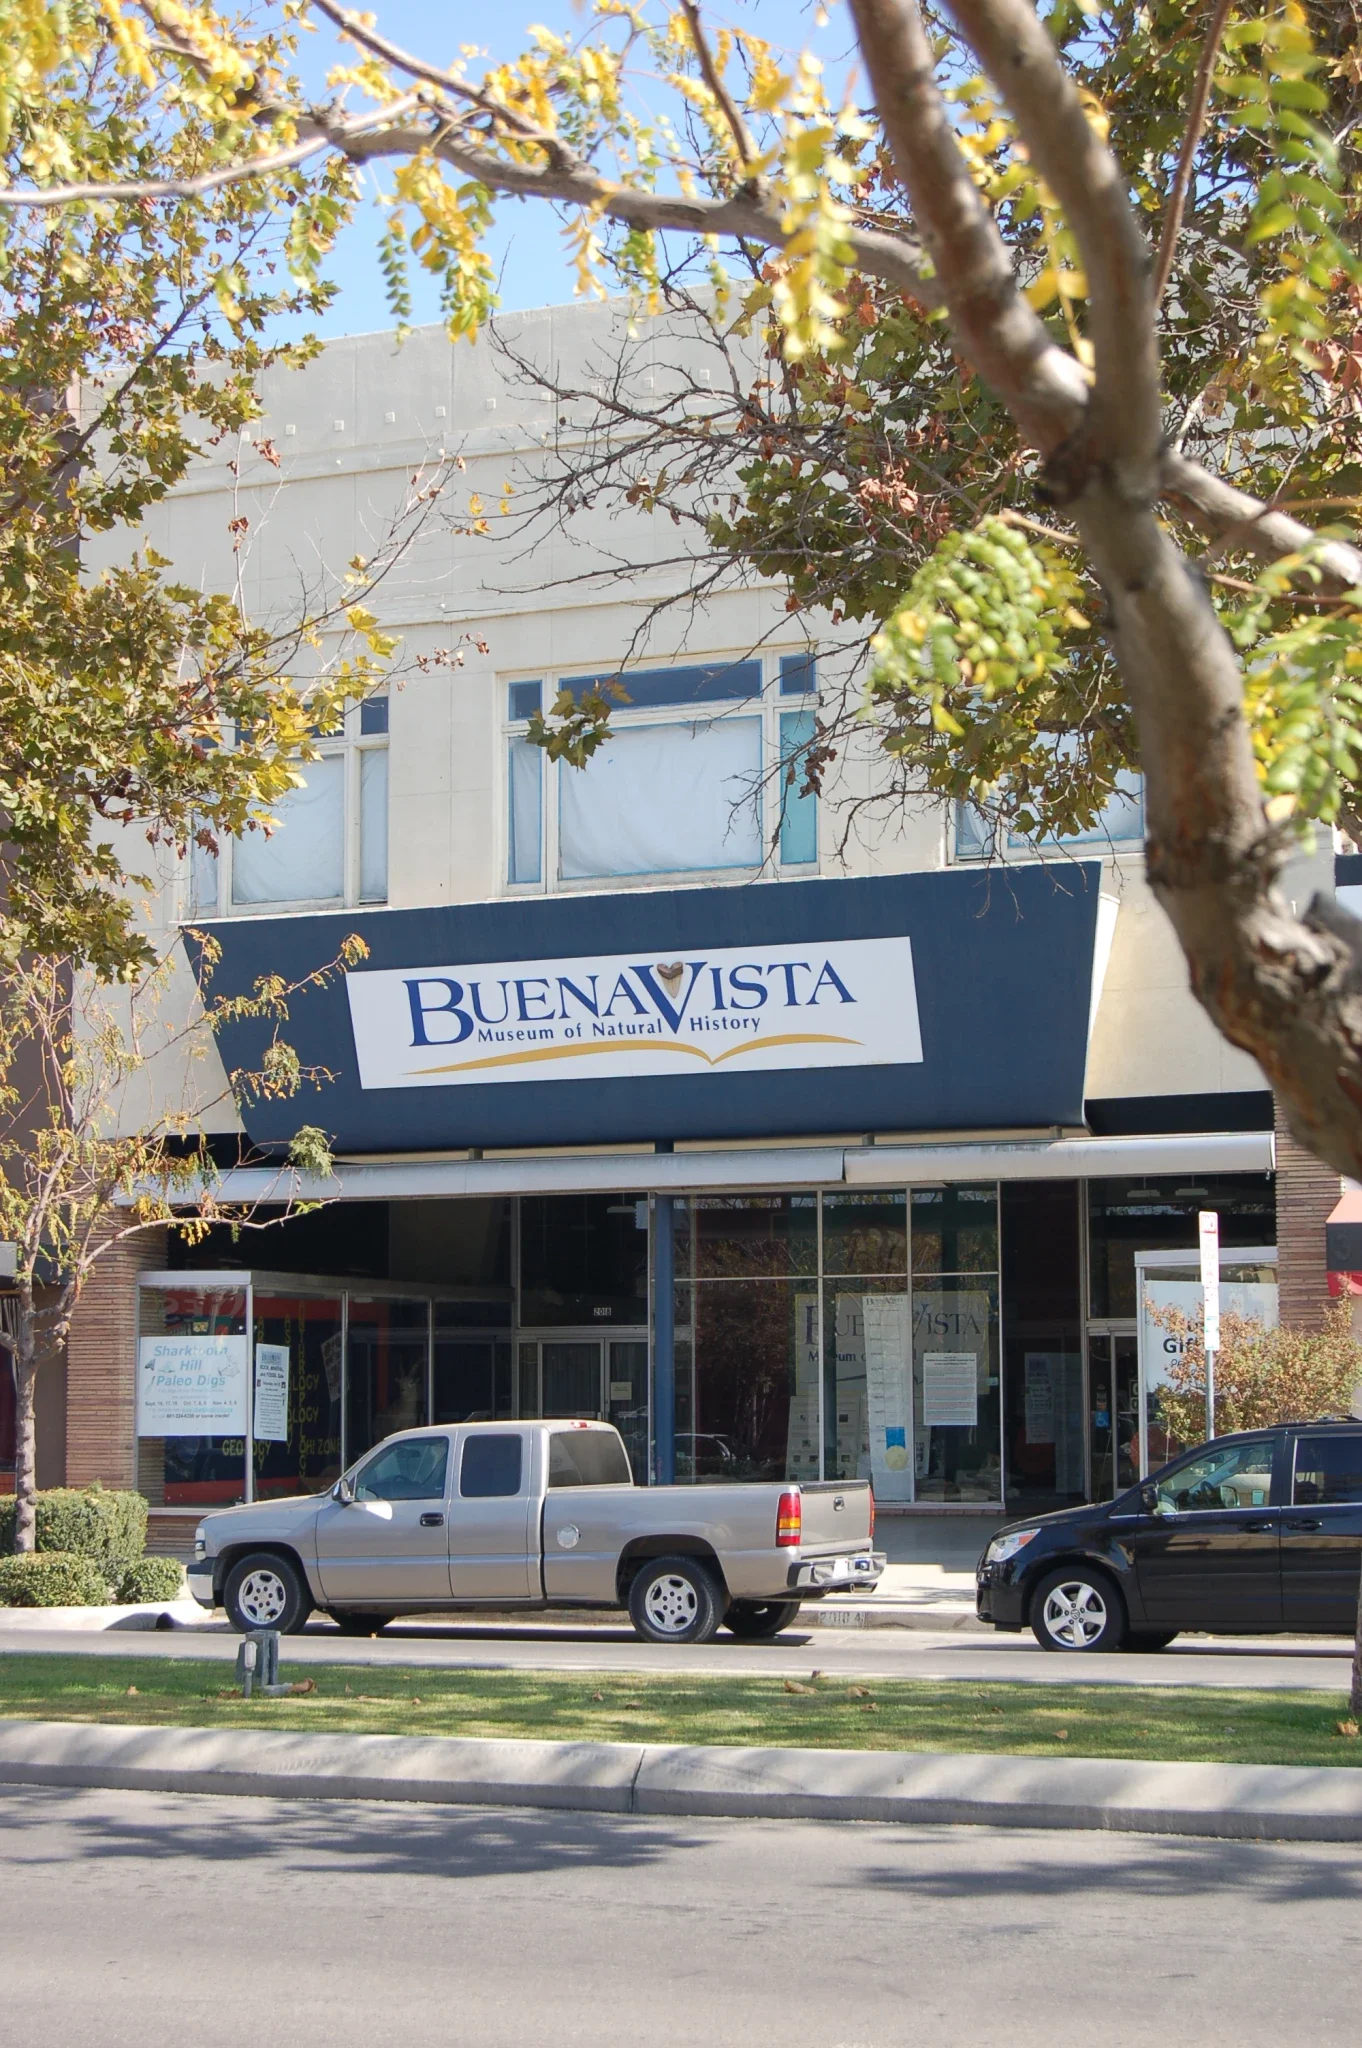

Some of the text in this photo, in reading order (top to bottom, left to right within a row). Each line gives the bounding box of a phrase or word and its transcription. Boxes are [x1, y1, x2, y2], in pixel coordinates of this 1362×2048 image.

[402, 959, 857, 1047] BUENA VISTA
[477, 1014, 761, 1043] Museum of Natural History
[180, 1360, 202, 1371] Hill
[156, 1374, 226, 1388] Paleo Digs
[222, 1440, 271, 1456] GEOOGY
